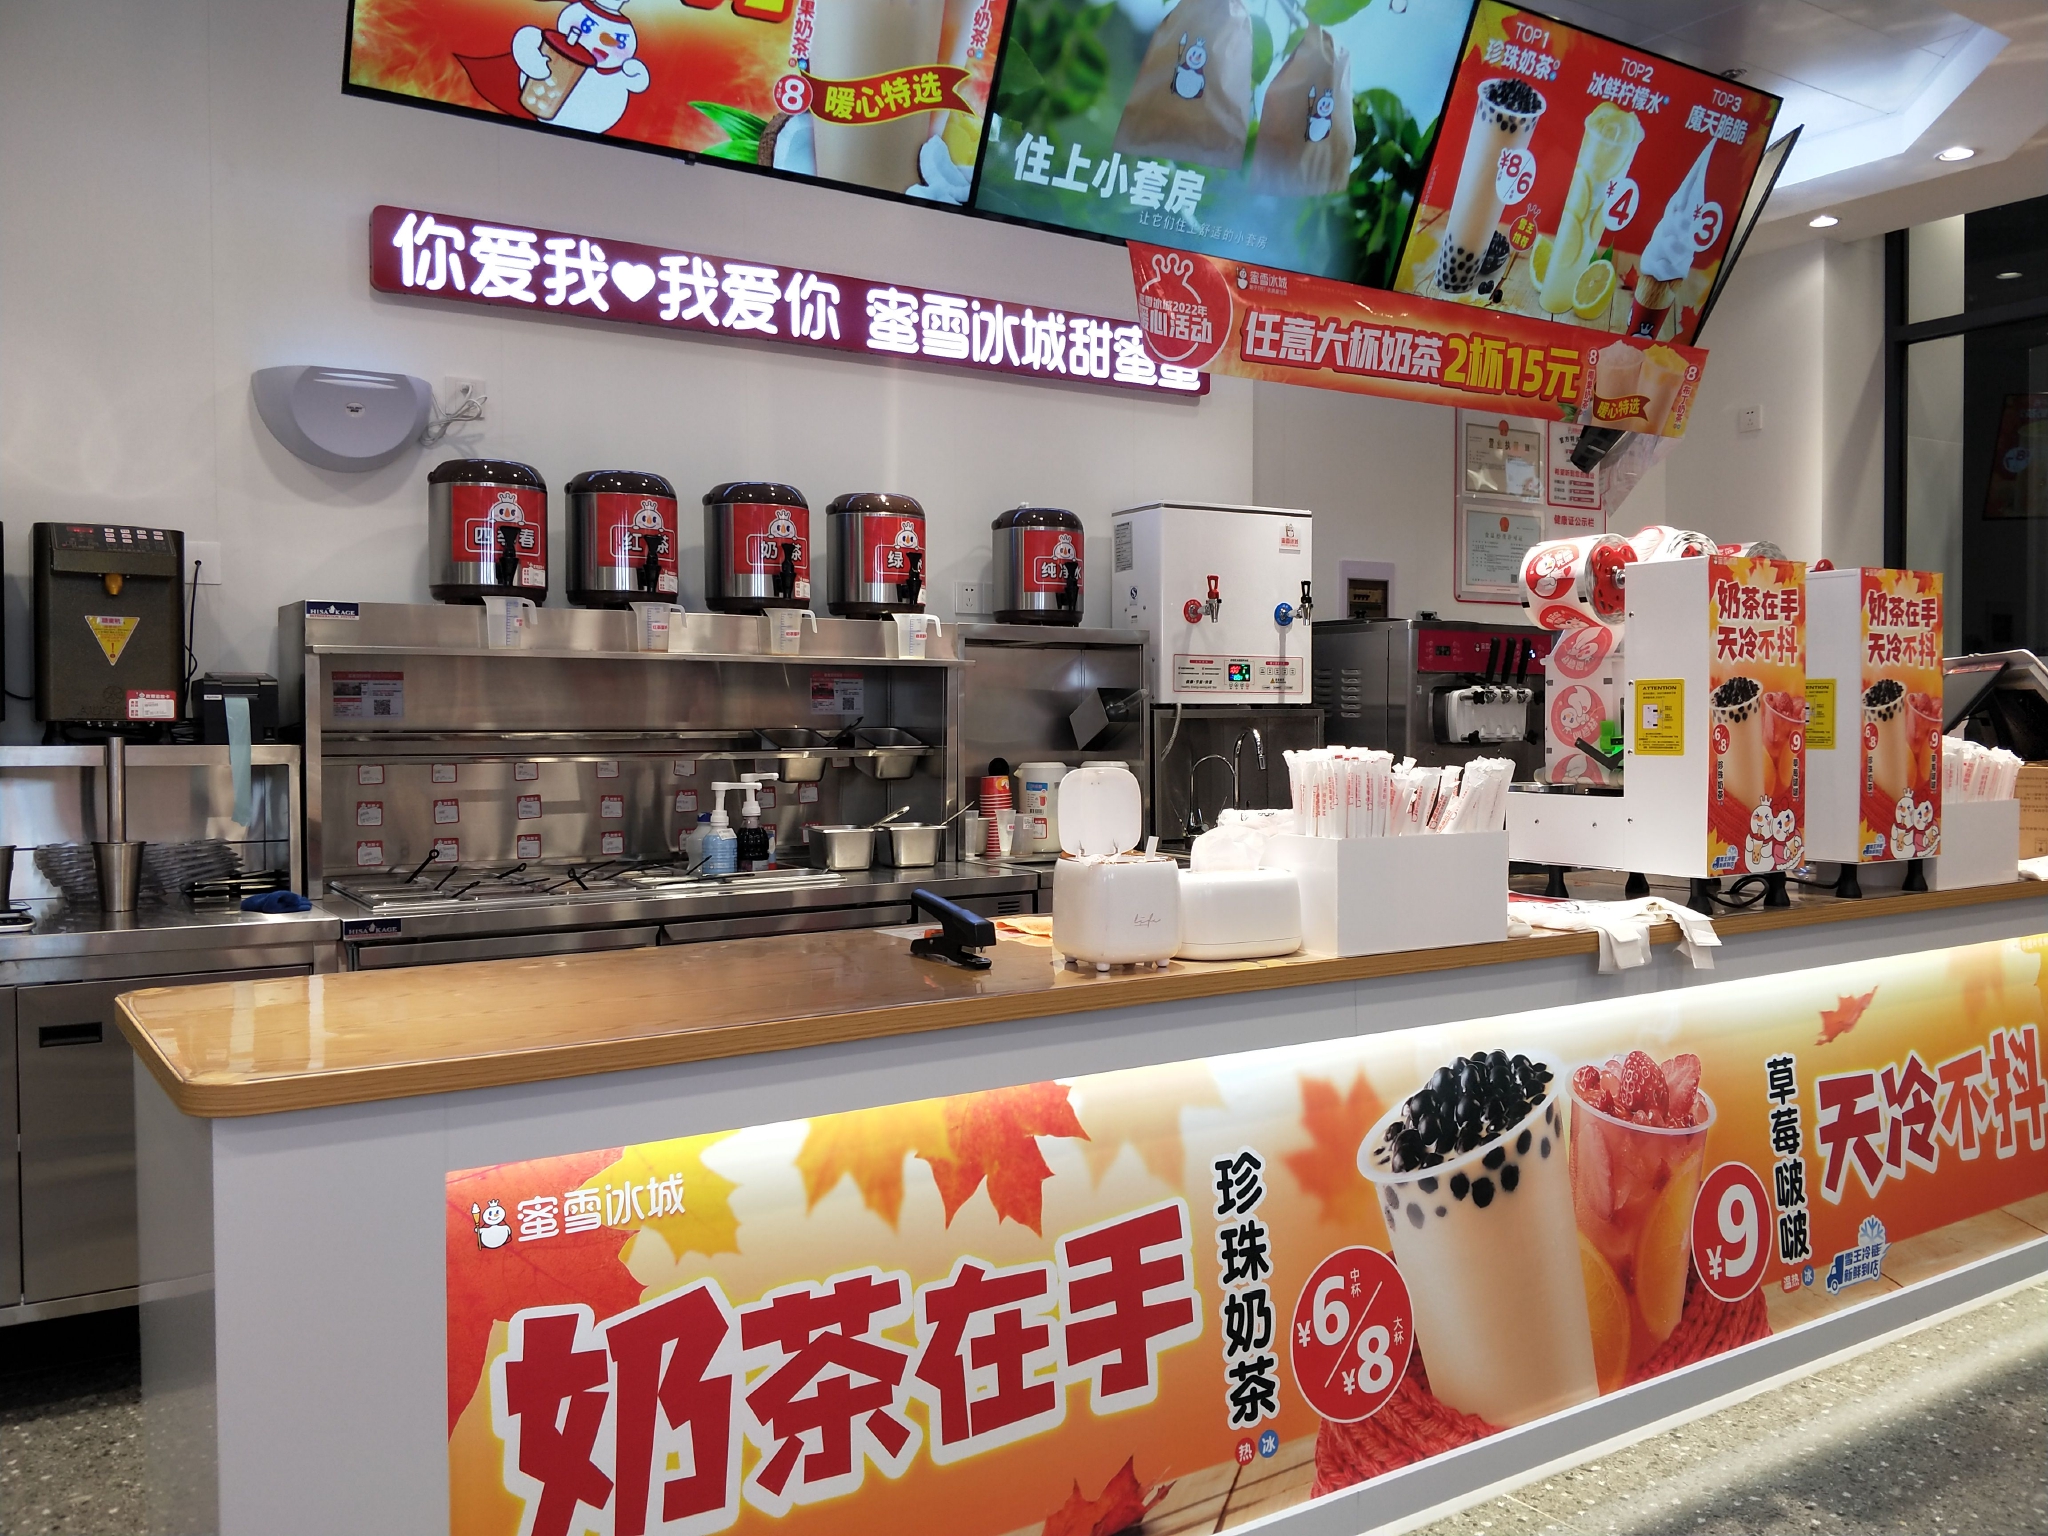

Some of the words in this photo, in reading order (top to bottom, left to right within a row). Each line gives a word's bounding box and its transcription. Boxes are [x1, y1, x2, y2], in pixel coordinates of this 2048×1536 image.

[1516, 22, 1549, 49] TOP1
[1484, 39, 1553, 80] 珍珠奶茶
[1621, 58, 1654, 83] TOP2
[824, 71, 943, 120] 暖心特选
[1587, 72, 1663, 114] 冰鲜柠檬水
[1712, 89, 1742, 112] TOP3
[1685, 105, 1748, 145] 魔天脆脆
[1014, 132, 1206, 215] 住上小套房
[1139, 210, 1269, 249] 让它们住上舒适的小套房
[393, 213, 609, 312] 你爱我
[658, 255, 841, 341] 我爱你
[1597, 398, 1641, 419] 暖心特选
[474, 527, 535, 549] 四春
[1554, 515, 1594, 528] 健康证公示栏
[1717, 580, 1798, 621] 奶茶在手
[1868, 590, 1937, 628] 奶茶在手
[1717, 625, 1798, 664] 天冷不抖
[1868, 632, 1937, 667] 天冷不抖
[1818, 1027, 2047, 1193] 天冷不抖
[1767, 1056, 1810, 1260] 草莓啵啵
[517, 1172, 686, 1243] 蜜雪冰城
[1844, 1242, 1882, 1267] 雪王冷链
[1844, 1259, 1879, 1284] 新鲜到店
[1214, 1151, 1277, 1424] 珍珠奶茶
[1350, 1268, 1362, 1298] 中杯
[1393, 1316, 1405, 1346] 大杯
[506, 1204, 1194, 1536] 奶茶在手
[1238, 1442, 1253, 1462] 热
[1261, 1437, 1275, 1454] 冰
